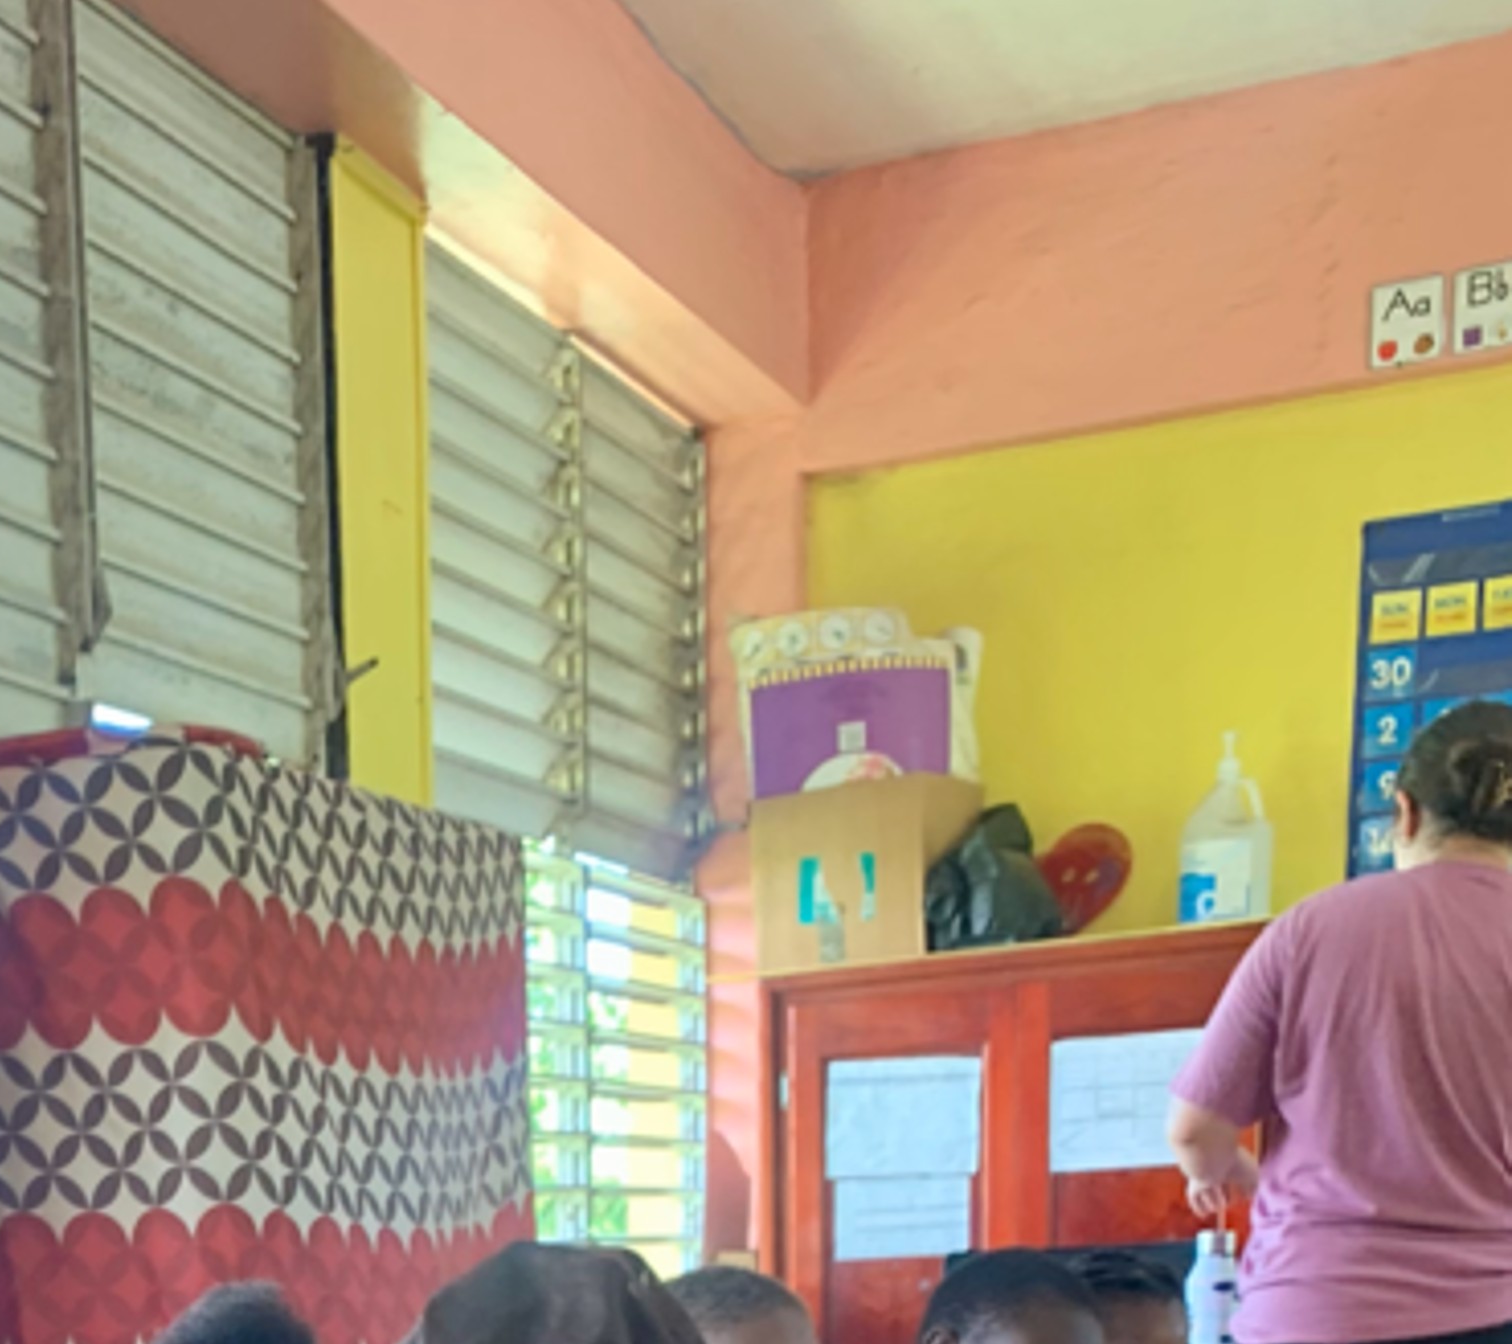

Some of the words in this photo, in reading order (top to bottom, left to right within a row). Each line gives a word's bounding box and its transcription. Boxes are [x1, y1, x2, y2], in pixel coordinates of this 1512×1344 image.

[1467, 269, 1509, 306] Bb
[1382, 288, 1431, 321] Aa
[1371, 656, 1411, 689] 30
[1377, 714, 1398, 745] 2
